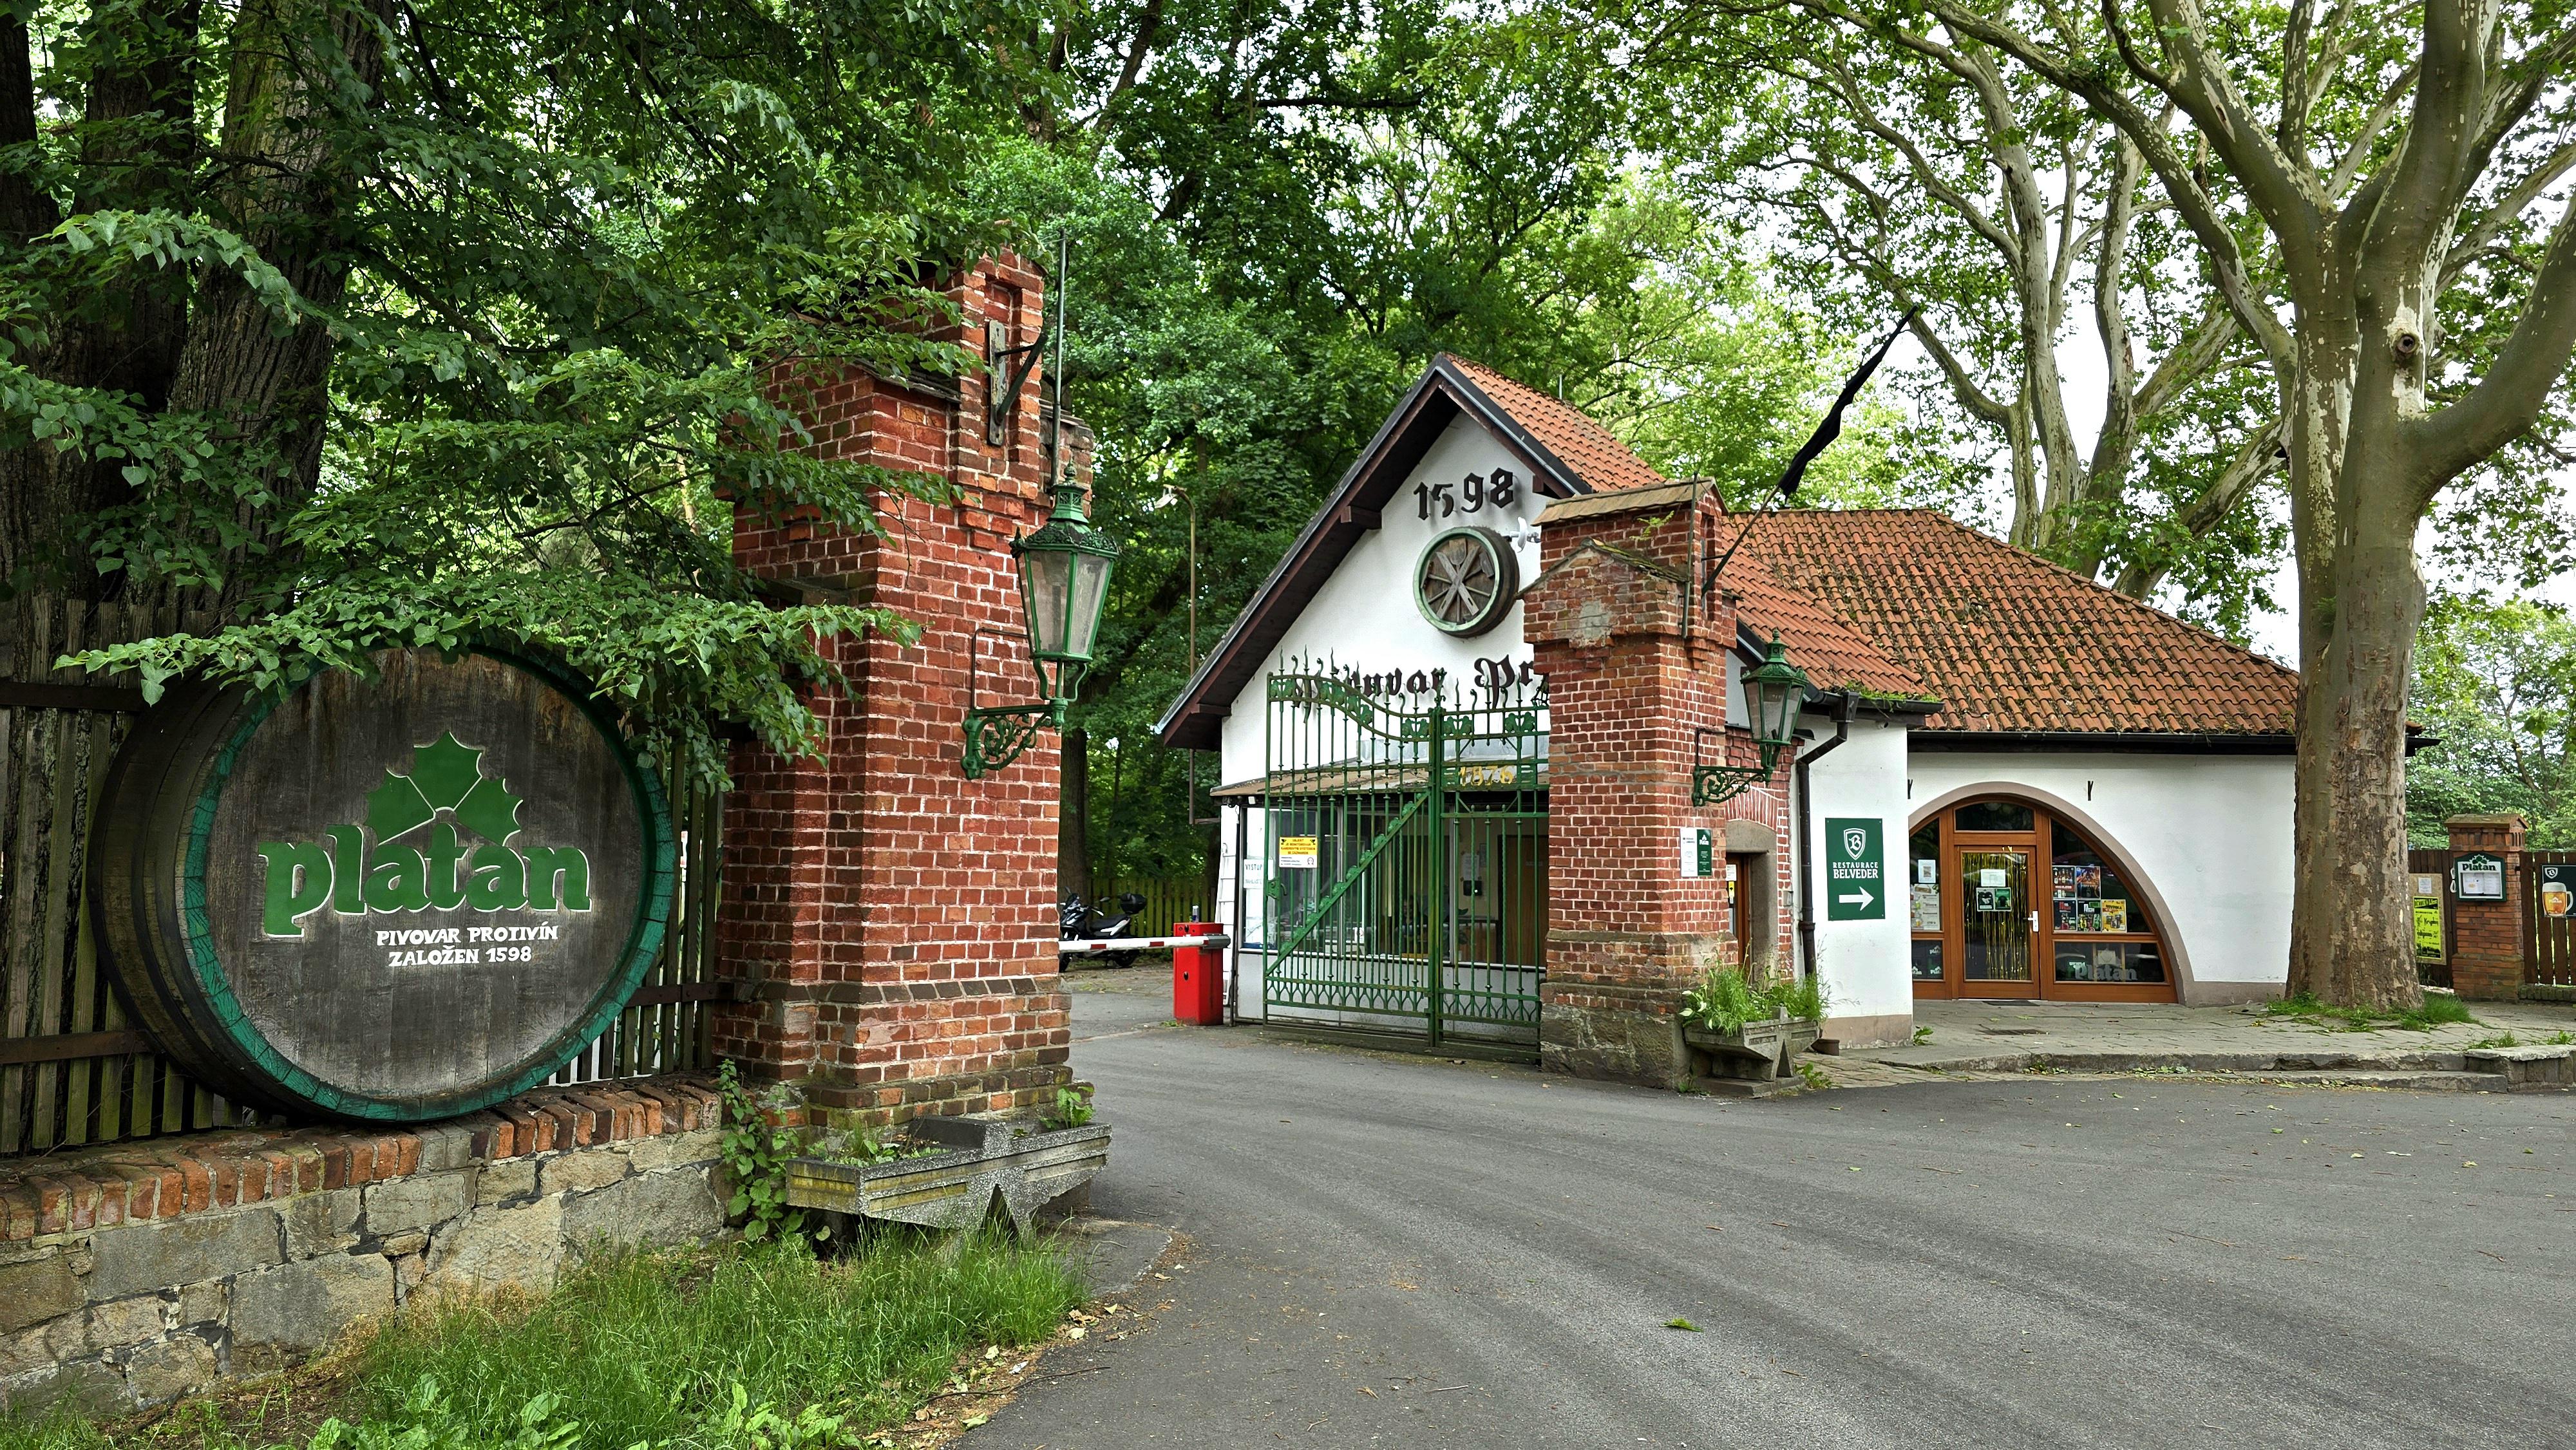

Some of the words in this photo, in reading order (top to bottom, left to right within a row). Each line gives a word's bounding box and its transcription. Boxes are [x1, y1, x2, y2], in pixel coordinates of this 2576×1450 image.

[1414, 467, 1513, 520] 1598
[258, 822, 592, 938] platan
[1833, 869, 1879, 879] BELVEDER
[375, 928, 462, 946] PIVOVAR
[467, 921, 558, 943] PROTIVÍN
[388, 945, 480, 967] ZALOŽEN
[485, 946, 532, 963] 1598
